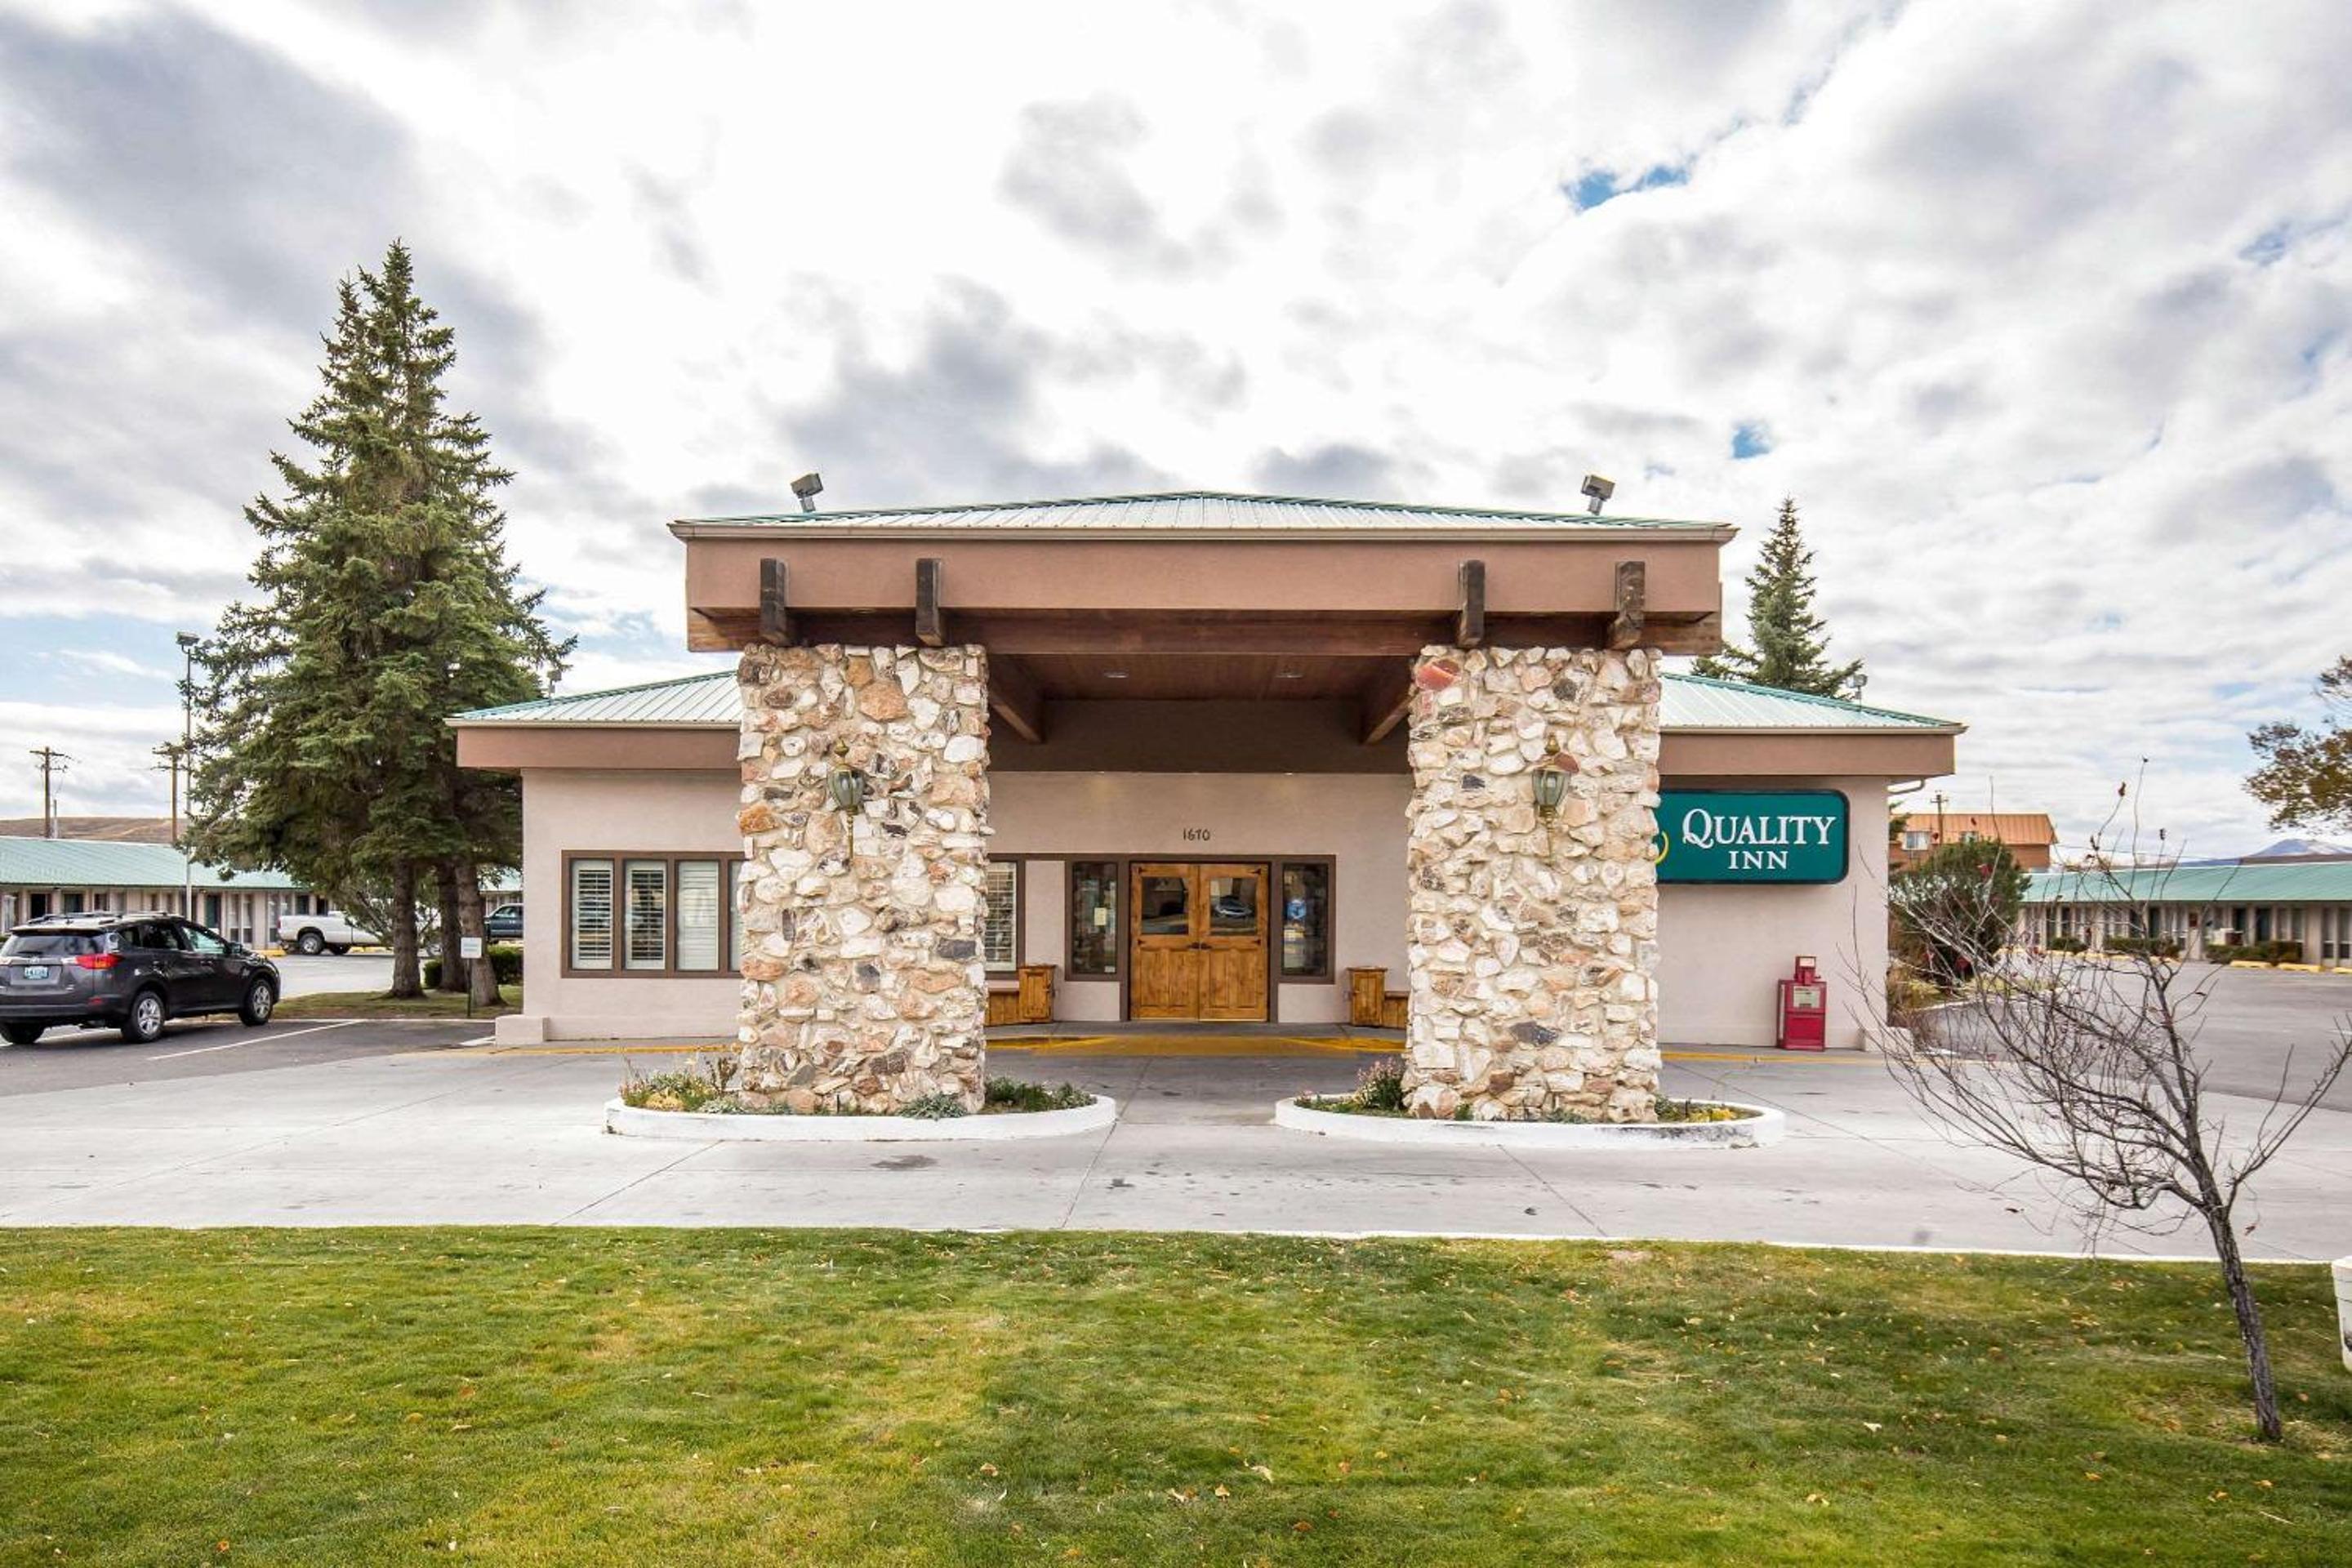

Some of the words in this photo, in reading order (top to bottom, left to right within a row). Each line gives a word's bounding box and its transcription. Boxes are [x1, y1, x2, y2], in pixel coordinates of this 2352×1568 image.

[1183, 828, 1210, 841] 1670
[1682, 808, 1837, 849] QUALITY
[1728, 850, 1788, 870] INN
